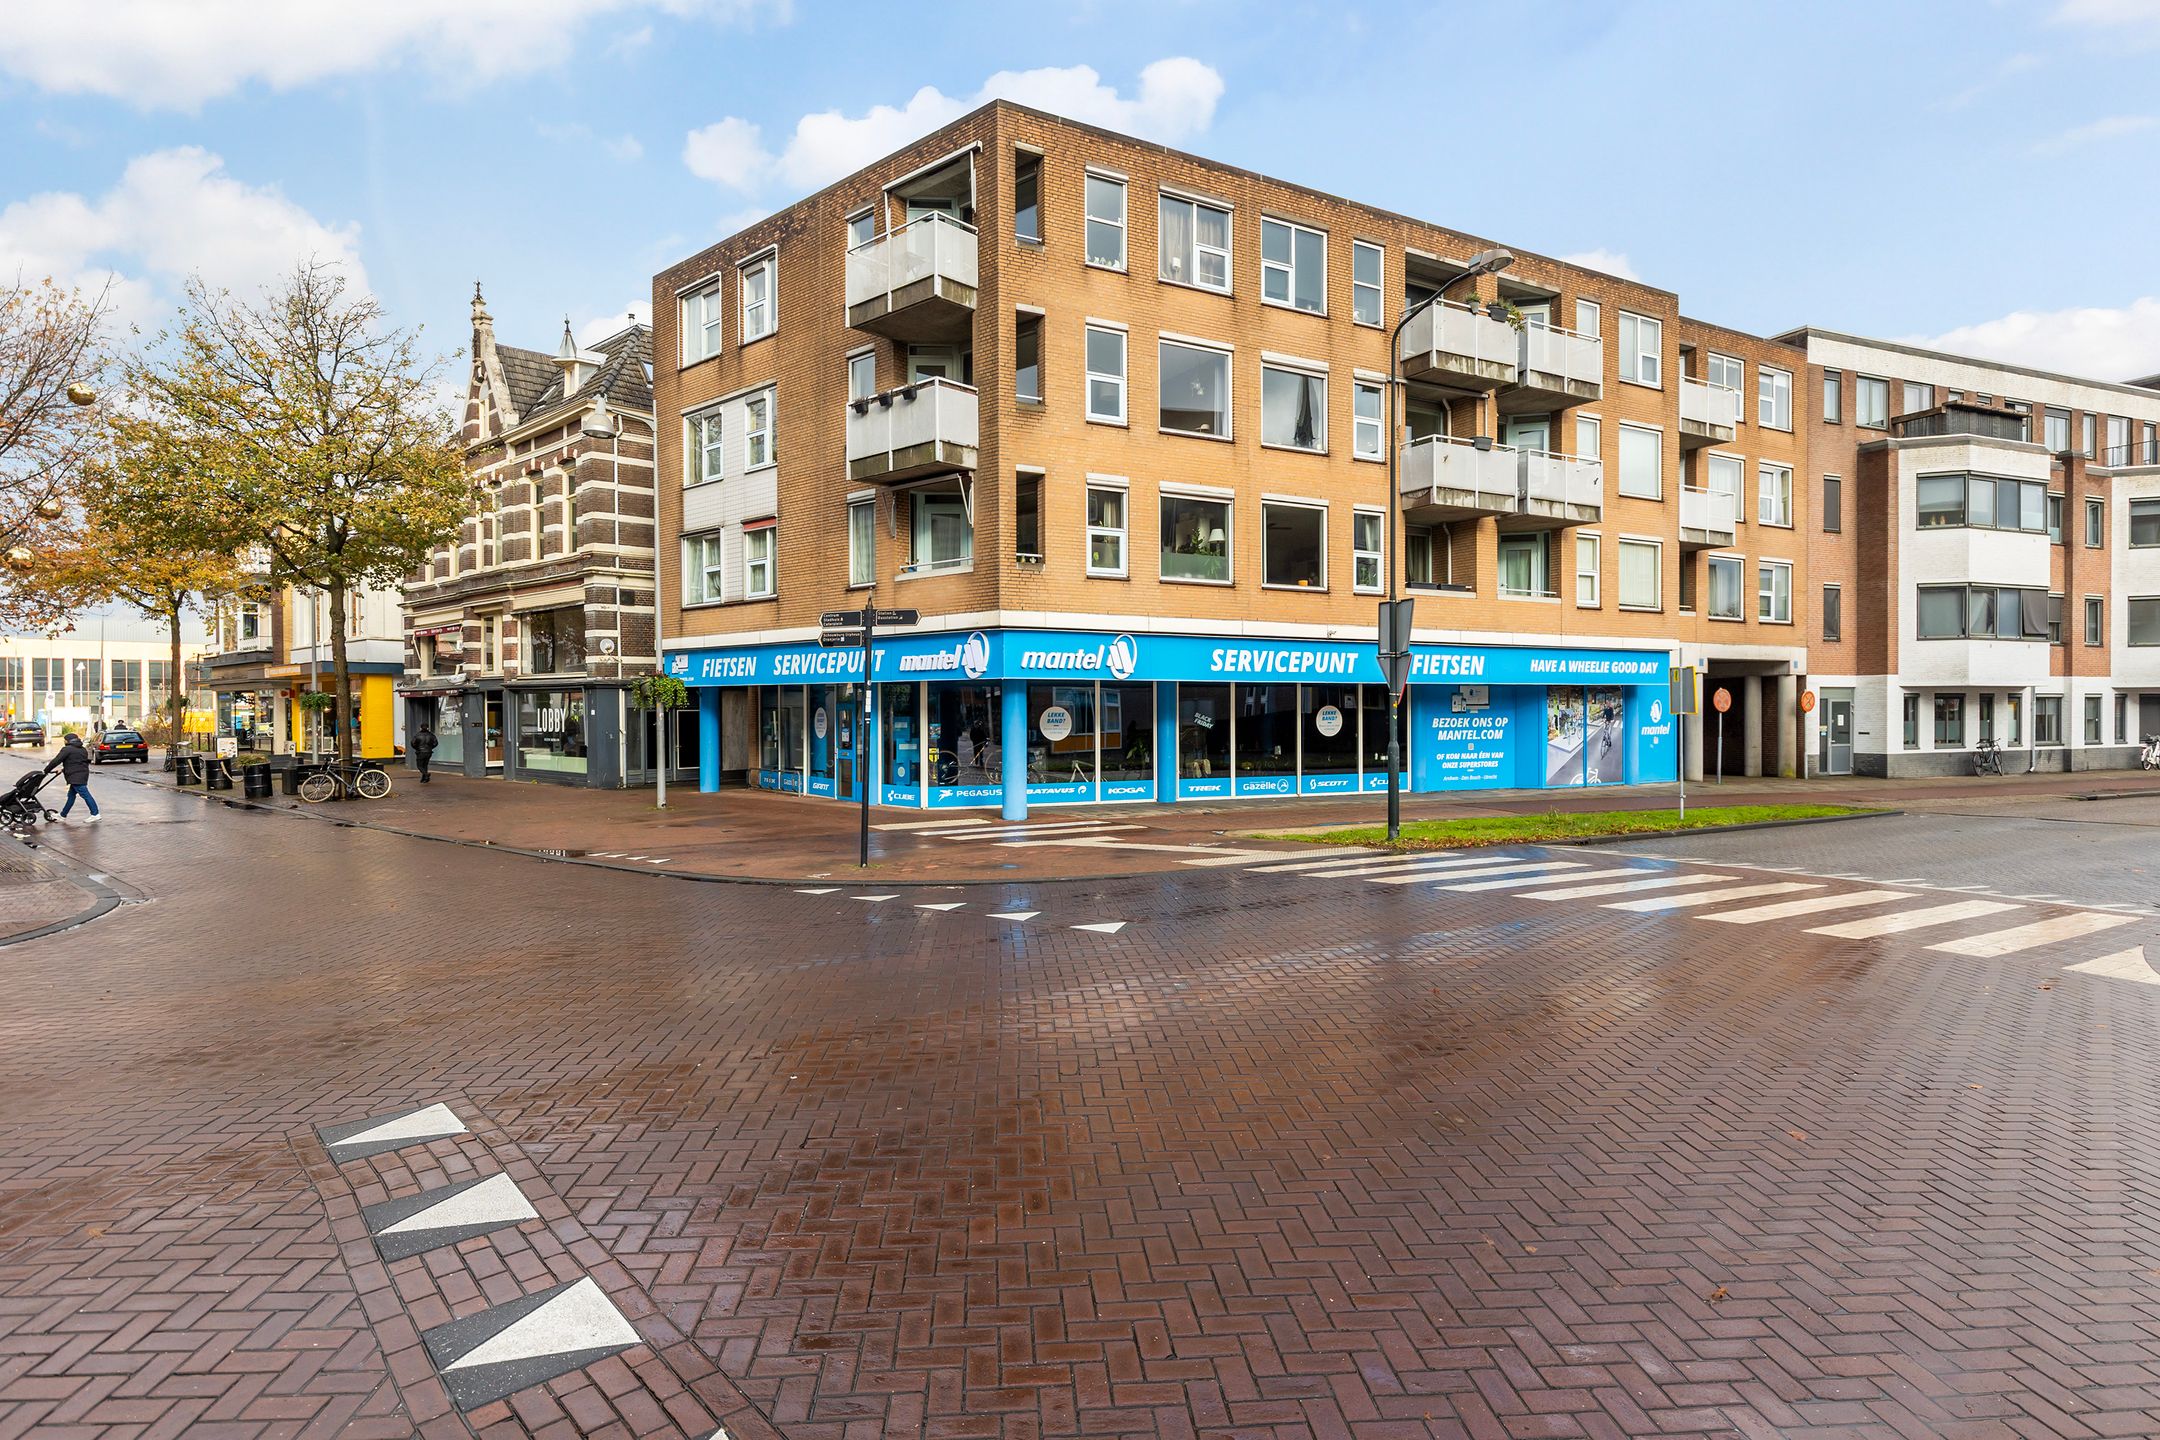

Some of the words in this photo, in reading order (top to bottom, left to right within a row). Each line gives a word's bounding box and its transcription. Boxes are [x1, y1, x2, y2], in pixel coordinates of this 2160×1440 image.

[701, 656, 757, 678] FIETSEN
[899, 644, 963, 671] mantel
[1020, 644, 1105, 670] mantel
[1210, 648, 1359, 674] SERVICEPUNT
[1412, 654, 1485, 676] FIETSEN
[1530, 659, 1558, 673] HAVE
[1558, 660, 1567, 673] A
[1568, 660, 1610, 673] WHEELIE
[1611, 661, 1638, 674] GOOD
[1639, 662, 1659, 674] DAY
[537, 707, 566, 732] LOBBY
[1432, 717, 1470, 728] BEZOEK
[1472, 717, 1493, 728] ONS
[1494, 717, 1509, 727] OP
[1641, 721, 1671, 735] mantel
[1437, 729, 1504, 741] MANTEL.COM
[1445, 752, 1460, 760] KOM
[1460, 752, 1478, 760] NAAR
[1491, 751, 1504, 759] VAN
[1442, 761, 1459, 769] ONZE
[1459, 760, 1499, 769] SUPERSTORES
[1243, 781, 1276, 791] Gazelle
[893, 793, 916, 801] CUBE
[956, 789, 1002, 797] PEGASUS
